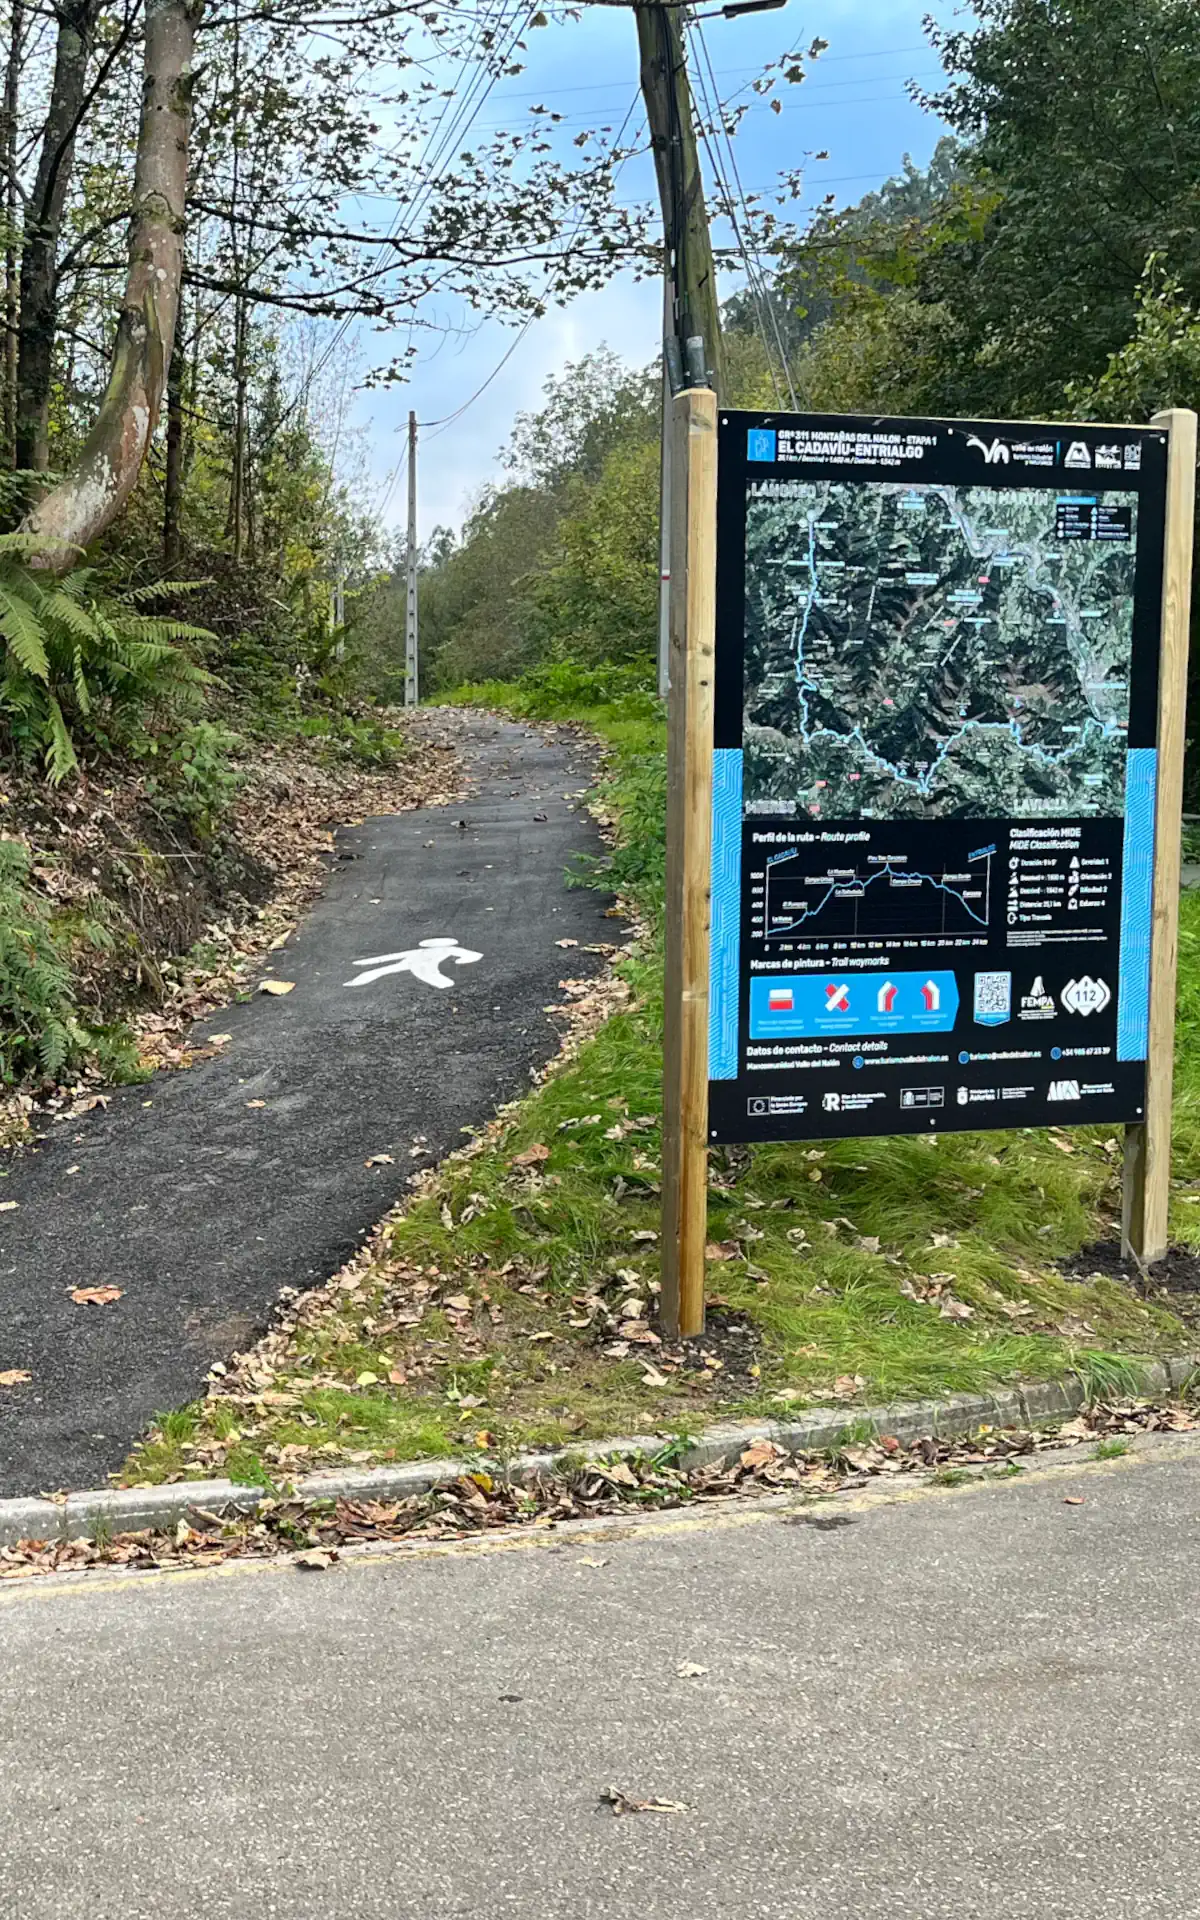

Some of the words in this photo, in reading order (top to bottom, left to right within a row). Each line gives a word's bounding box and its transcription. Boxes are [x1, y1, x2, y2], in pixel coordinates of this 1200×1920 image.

[811, 430, 855, 442] MONTAÑAS
[856, 433, 872, 443] DEL
[906, 435, 931, 446] ETAPA
[932, 436, 937, 446] 1
[778, 440, 794, 453] EL
[752, 831, 775, 843] Perfil
[776, 833, 786, 842] de
[787, 832, 796, 842] la
[797, 832, 815, 842] ruta
[821, 832, 844, 842] Route
[845, 831, 871, 844] profile
[1060, 827, 1081, 838] MIDE
[750, 959, 781, 970] Marcas
[782, 959, 793, 968] de
[793, 958, 824, 970] pintura
[831, 957, 848, 967] Trail
[848, 956, 890, 968] waymarks
[1021, 996, 1055, 1008] FEMPA
[1076, 990, 1097, 1003] 112
[746, 1046, 772, 1056] Datos
[773, 1045, 784, 1055] de
[785, 1044, 822, 1055] contacto
[829, 1042, 860, 1053] Contact
[861, 1040, 888, 1051] details
